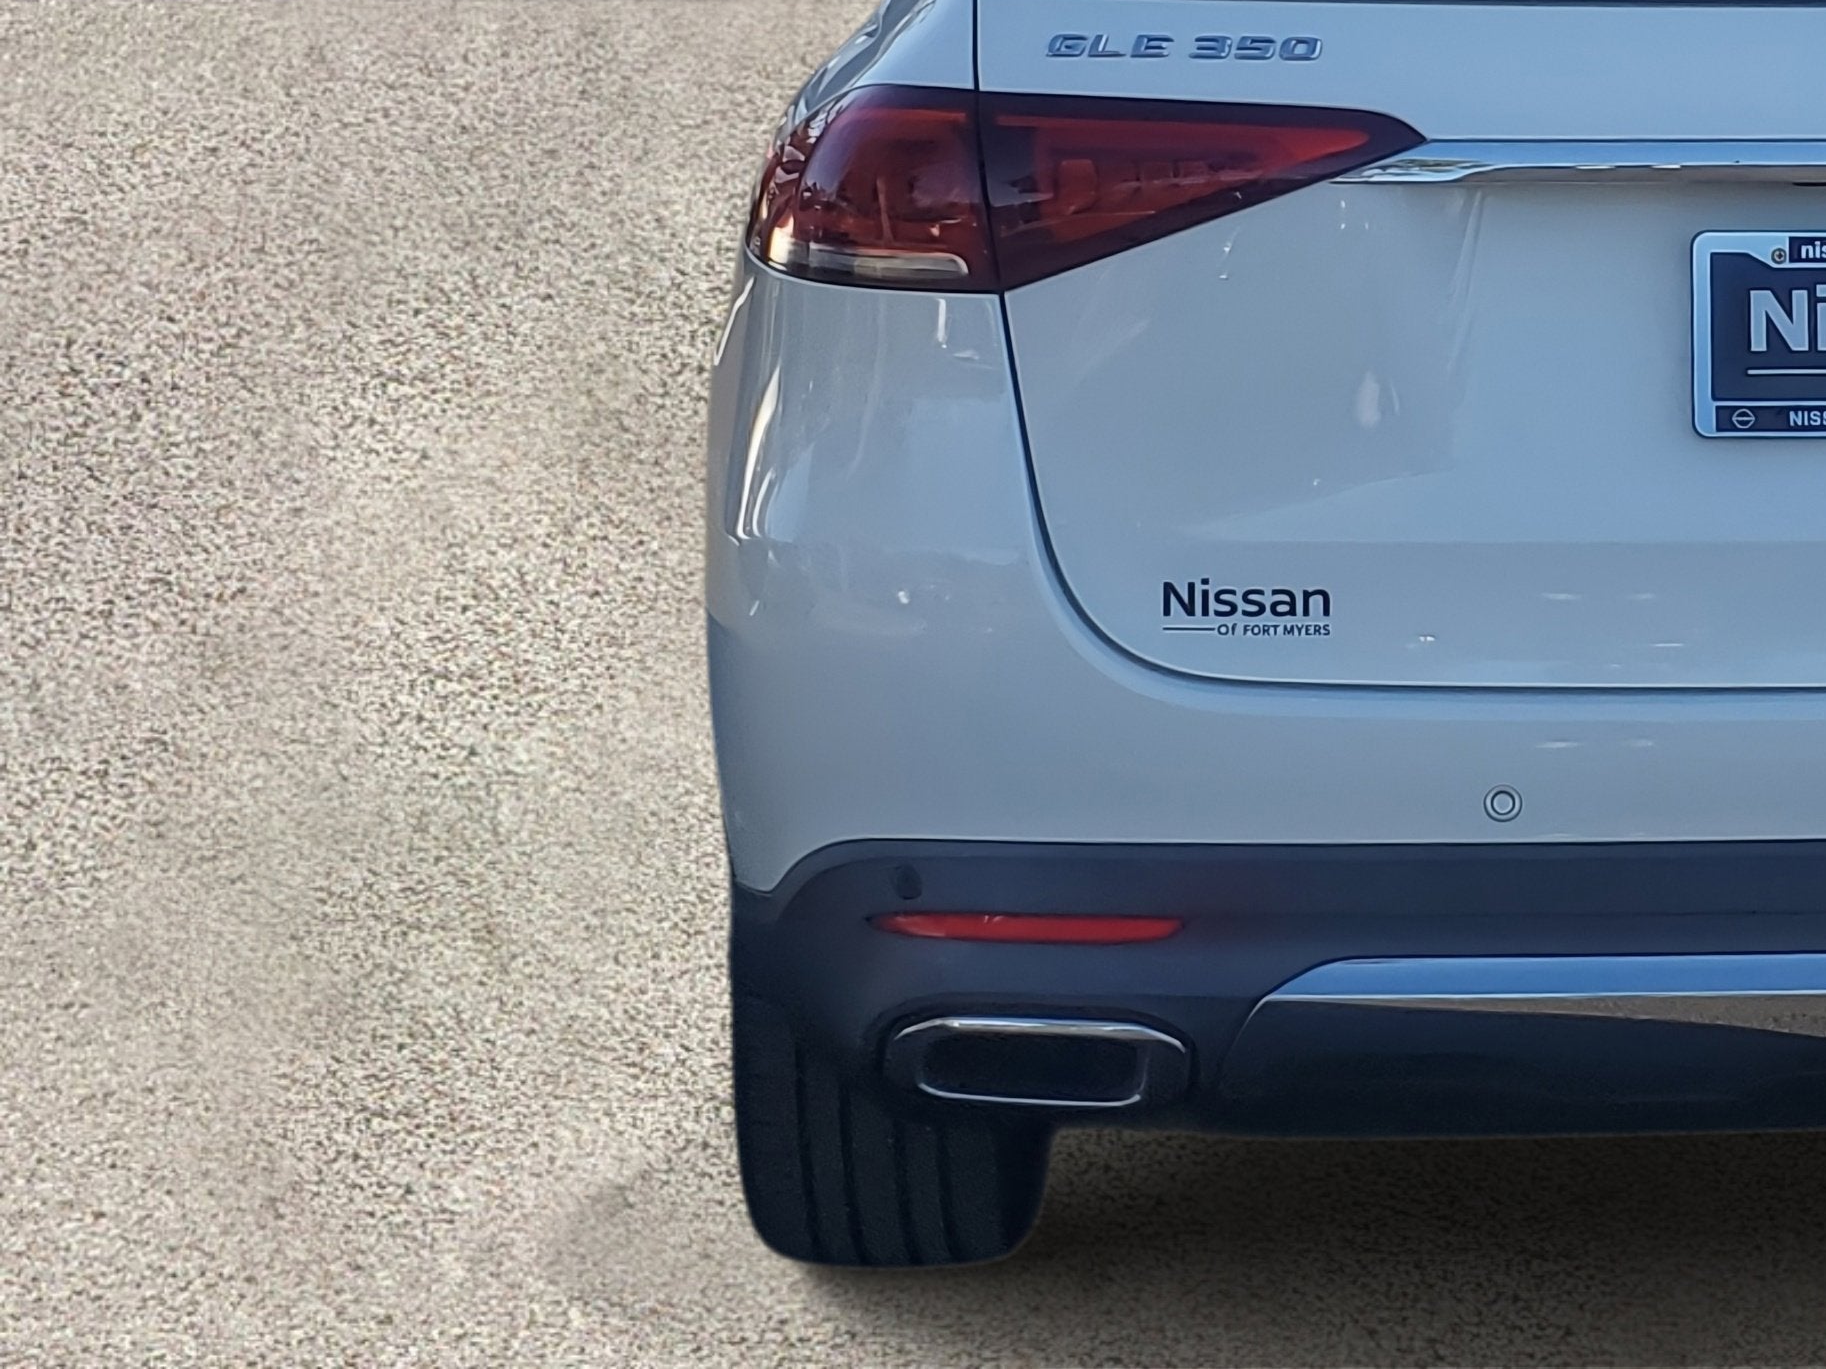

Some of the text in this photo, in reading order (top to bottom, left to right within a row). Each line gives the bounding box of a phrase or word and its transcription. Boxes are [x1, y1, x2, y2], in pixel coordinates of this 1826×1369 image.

[1046, 34, 1323, 61] GLE 350
[1163, 577, 1331, 617] Nissan
[1243, 624, 1280, 636] FORT
[1283, 624, 1331, 636] MYERS
